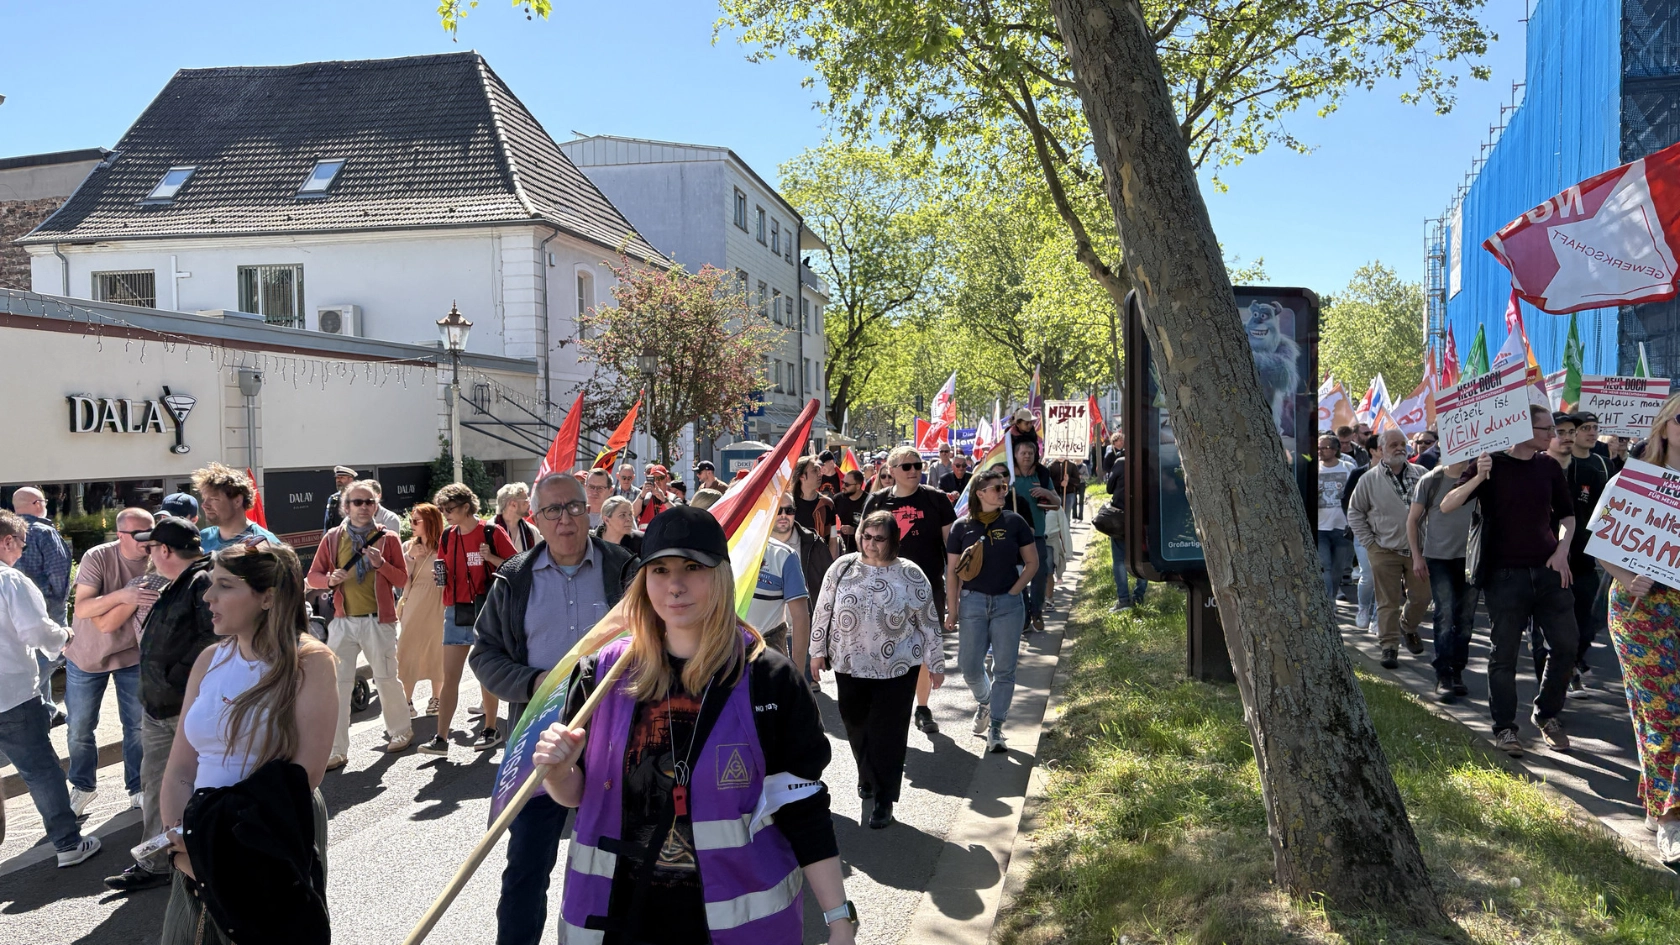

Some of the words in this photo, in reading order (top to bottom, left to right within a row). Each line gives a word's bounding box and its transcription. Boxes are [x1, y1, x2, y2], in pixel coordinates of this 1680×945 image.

[1479, 370, 1502, 393] DOCH
[1624, 378, 1647, 391] DOCH
[1494, 394, 1509, 409] ist
[1589, 395, 1635, 409] Applaus
[1595, 412, 1623, 425] CHT
[1446, 420, 1480, 450] KEIN
[397, 485, 415, 494] DALAY
[289, 492, 313, 503] DALAY
[1647, 491, 1660, 501] FÜR
[1661, 496, 1679, 507] MEHR
[1609, 496, 1642, 518] Wir
[1645, 507, 1680, 538] halte
[1595, 514, 1680, 569] ZUSAM
